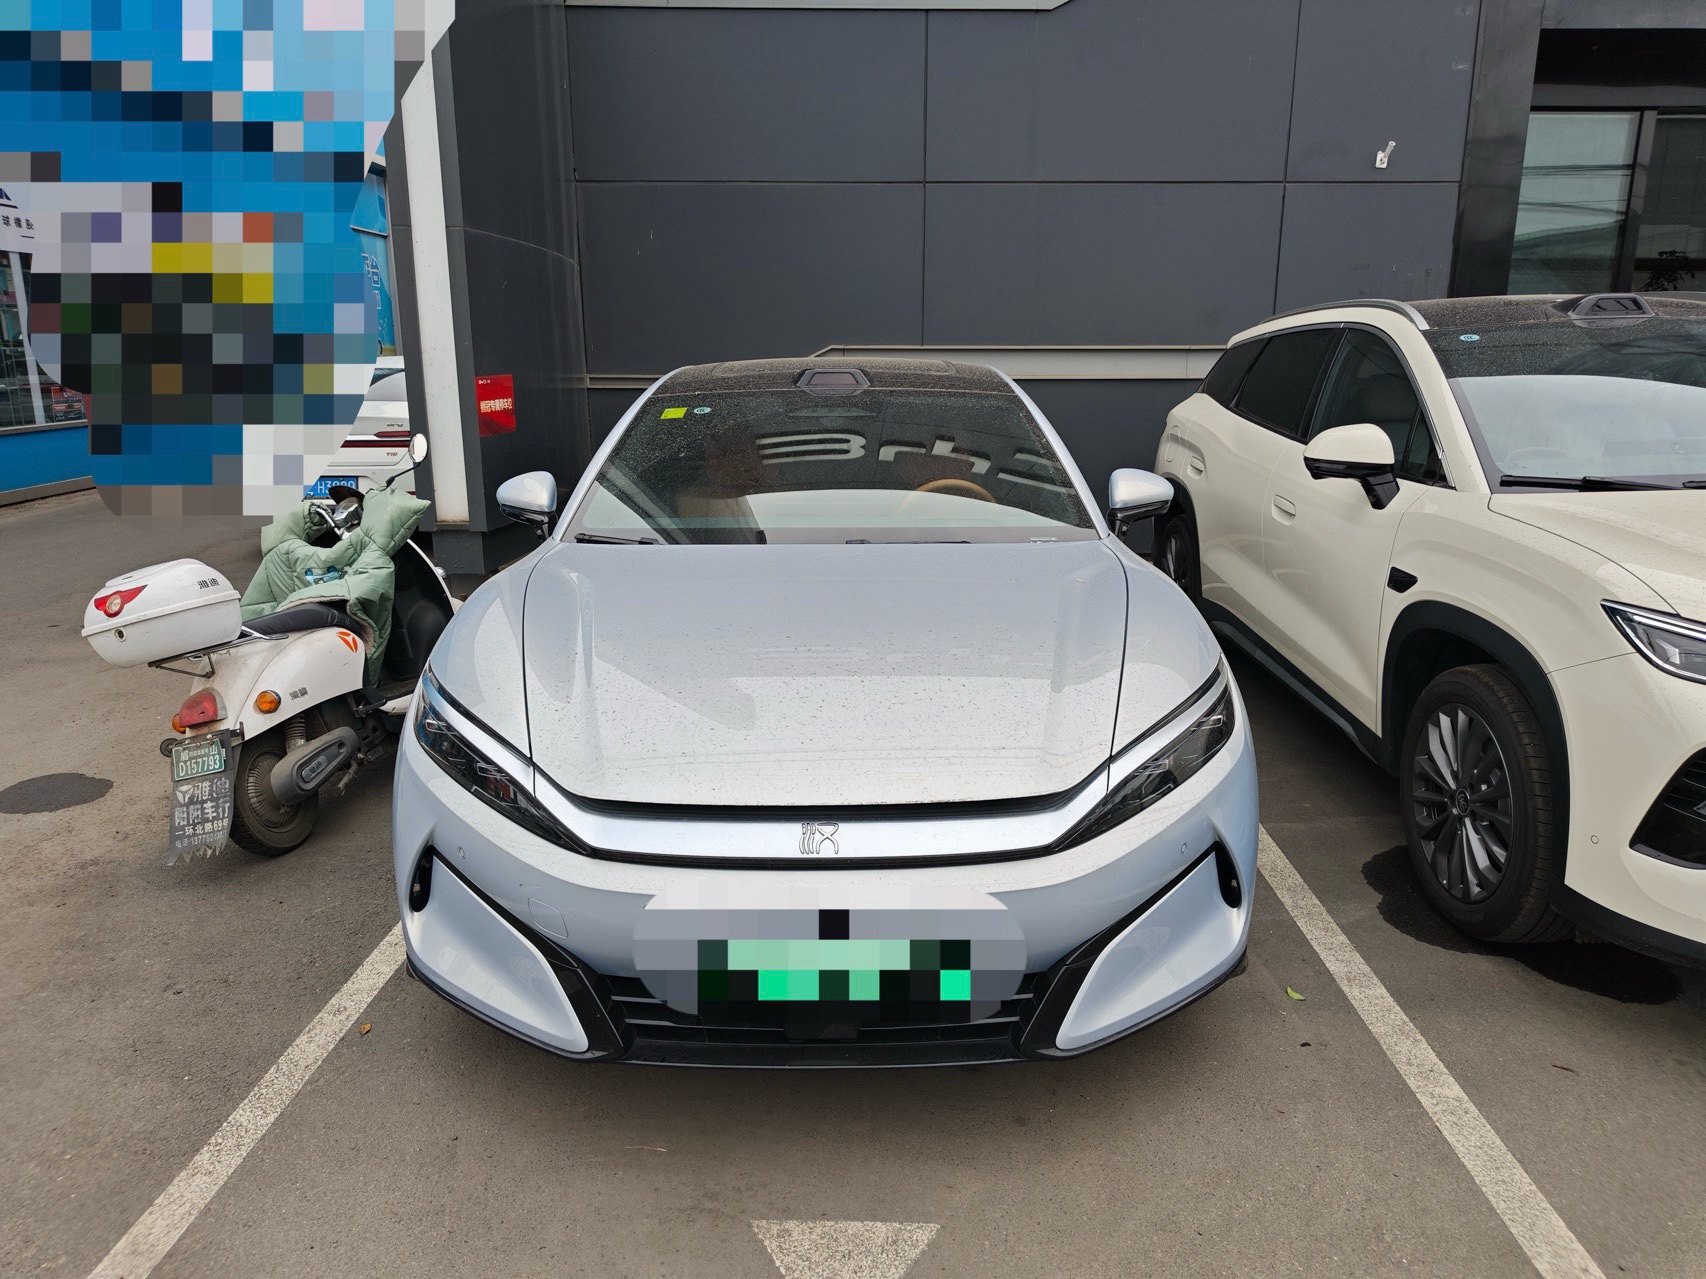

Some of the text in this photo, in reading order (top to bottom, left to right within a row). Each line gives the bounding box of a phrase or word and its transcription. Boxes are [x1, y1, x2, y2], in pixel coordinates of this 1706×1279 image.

[197, 578, 220, 590] 雅迪
[179, 754, 220, 777] D157793
[193, 777, 230, 802] 雅迪
